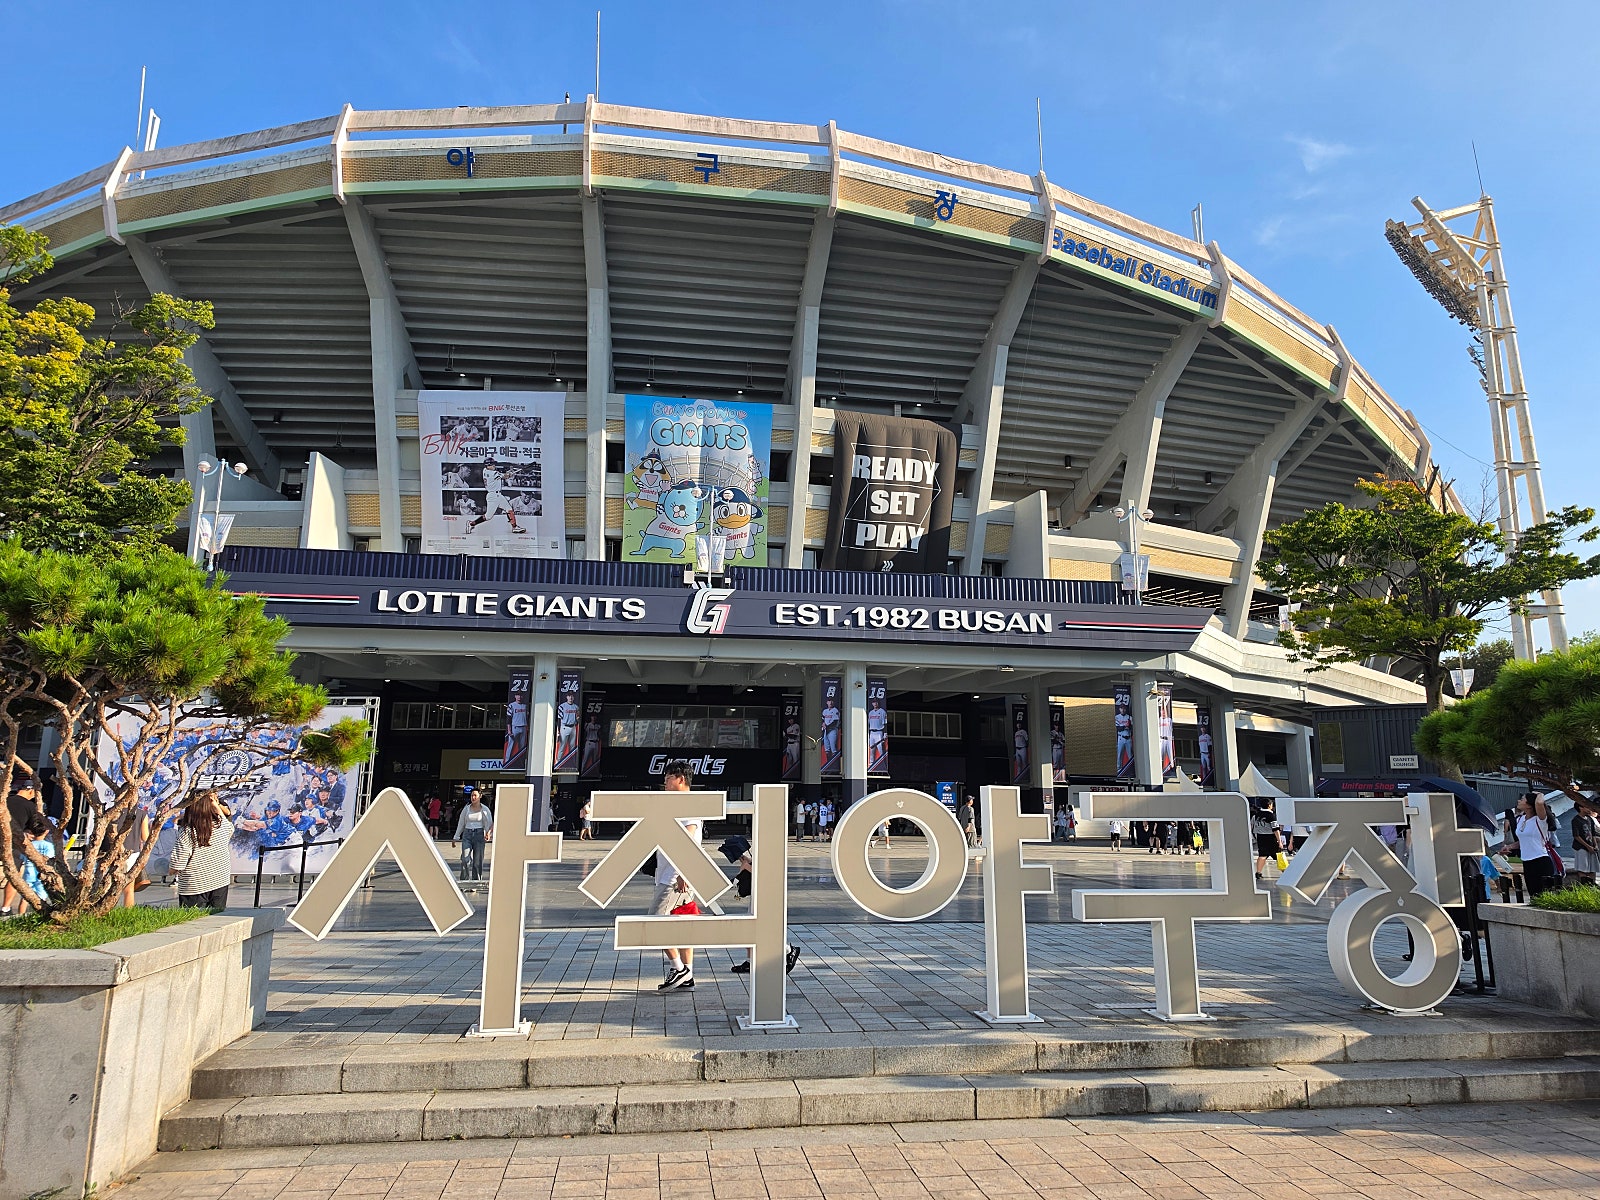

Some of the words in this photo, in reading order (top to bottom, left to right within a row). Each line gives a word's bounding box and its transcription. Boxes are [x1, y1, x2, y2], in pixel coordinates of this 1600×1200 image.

[447, 147, 477, 177] 야
[694, 153, 720, 182] 구
[934, 190, 958, 221] 장
[1052, 228, 1139, 280] Baseball
[1138, 262, 1218, 310] Stadium
[650, 418, 748, 450] GIANTS
[459, 446, 498, 459] 가을야구
[852, 453, 940, 485] READY
[870, 489, 920, 516] SET
[658, 521, 682, 535] Giants
[725, 532, 748, 541] Giants
[855, 522, 925, 550] PLAY
[377, 589, 499, 615] LOTTE
[507, 594, 646, 621] GIANTS
[775, 603, 931, 630] EST.1982
[938, 608, 1053, 634] BUSAN
[511, 679, 529, 692] 21
[560, 680, 579, 693] 34
[826, 685, 837, 698] 8
[868, 686, 886, 699] 16
[1115, 693, 1131, 706] 29
[586, 702, 603, 713] 55
[648, 754, 728, 775] Gnts
[1341, 782, 1373, 790] Uniform
[1374, 782, 1395, 791] Shop
[287, 784, 1485, 1034] 사직야구장
